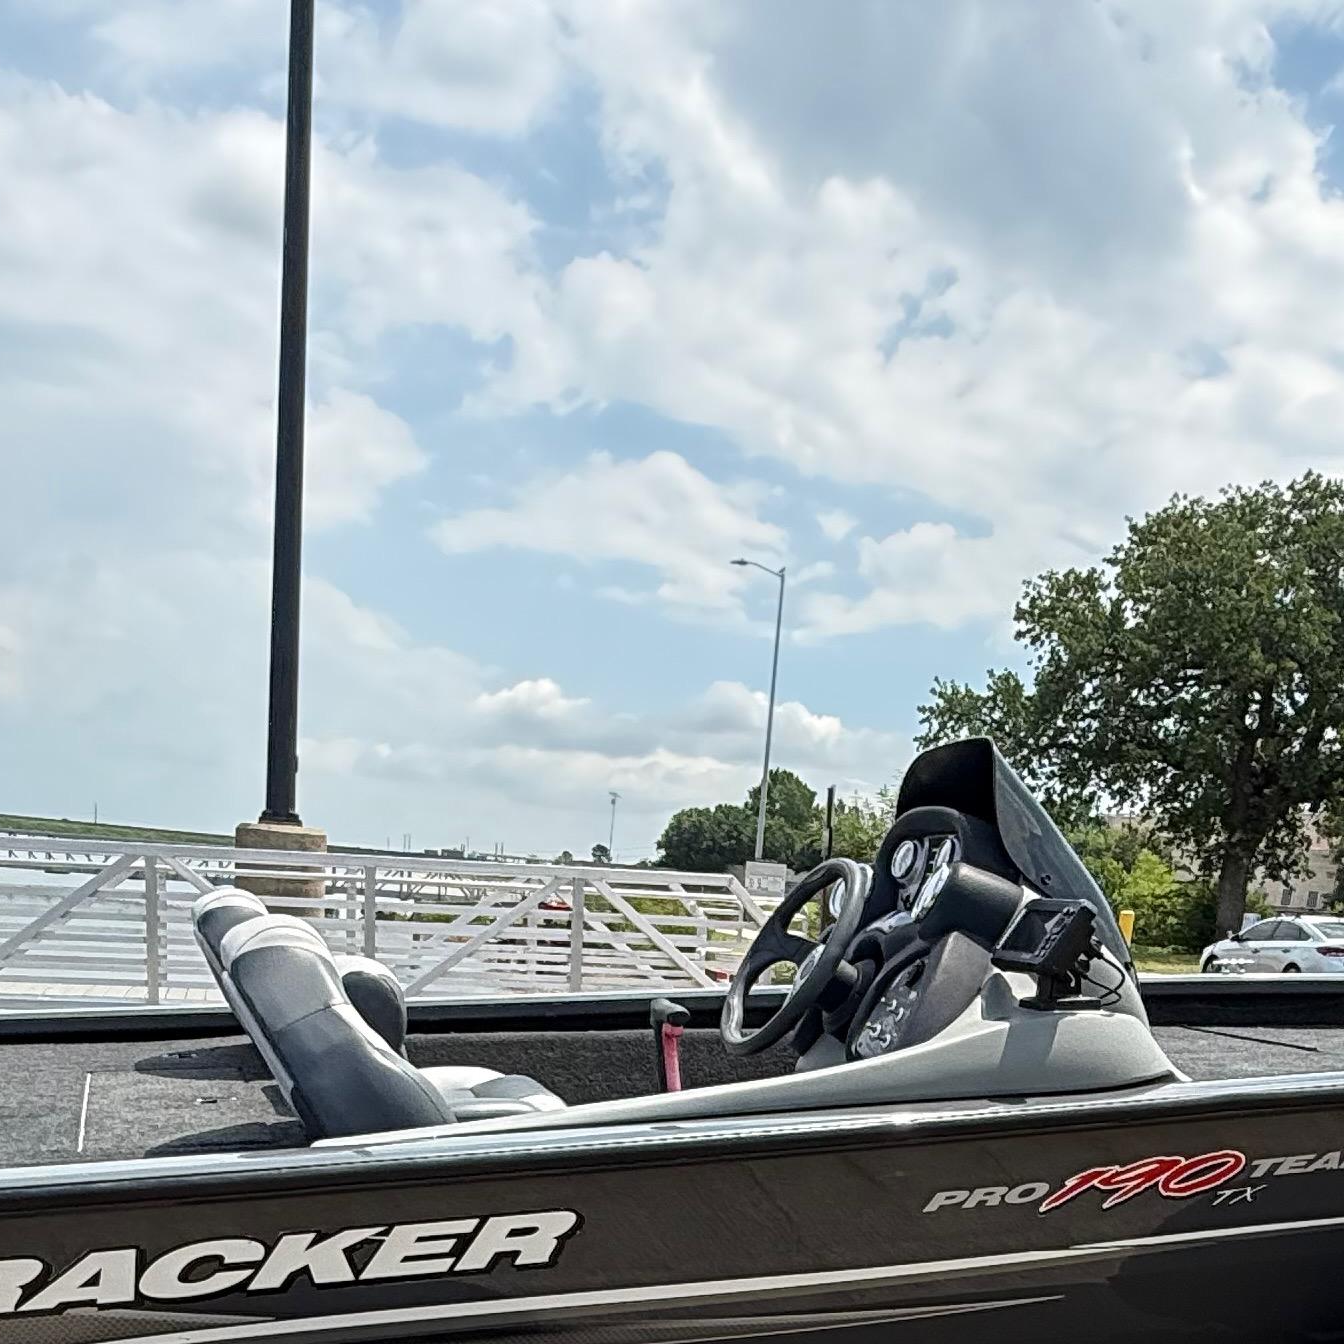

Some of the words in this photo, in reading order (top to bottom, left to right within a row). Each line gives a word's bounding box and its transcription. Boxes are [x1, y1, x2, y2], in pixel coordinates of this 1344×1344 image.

[922, 1182, 1050, 1213] PRO
[1038, 1150, 1246, 1214] 190
[1211, 1184, 1267, 1206] TX
